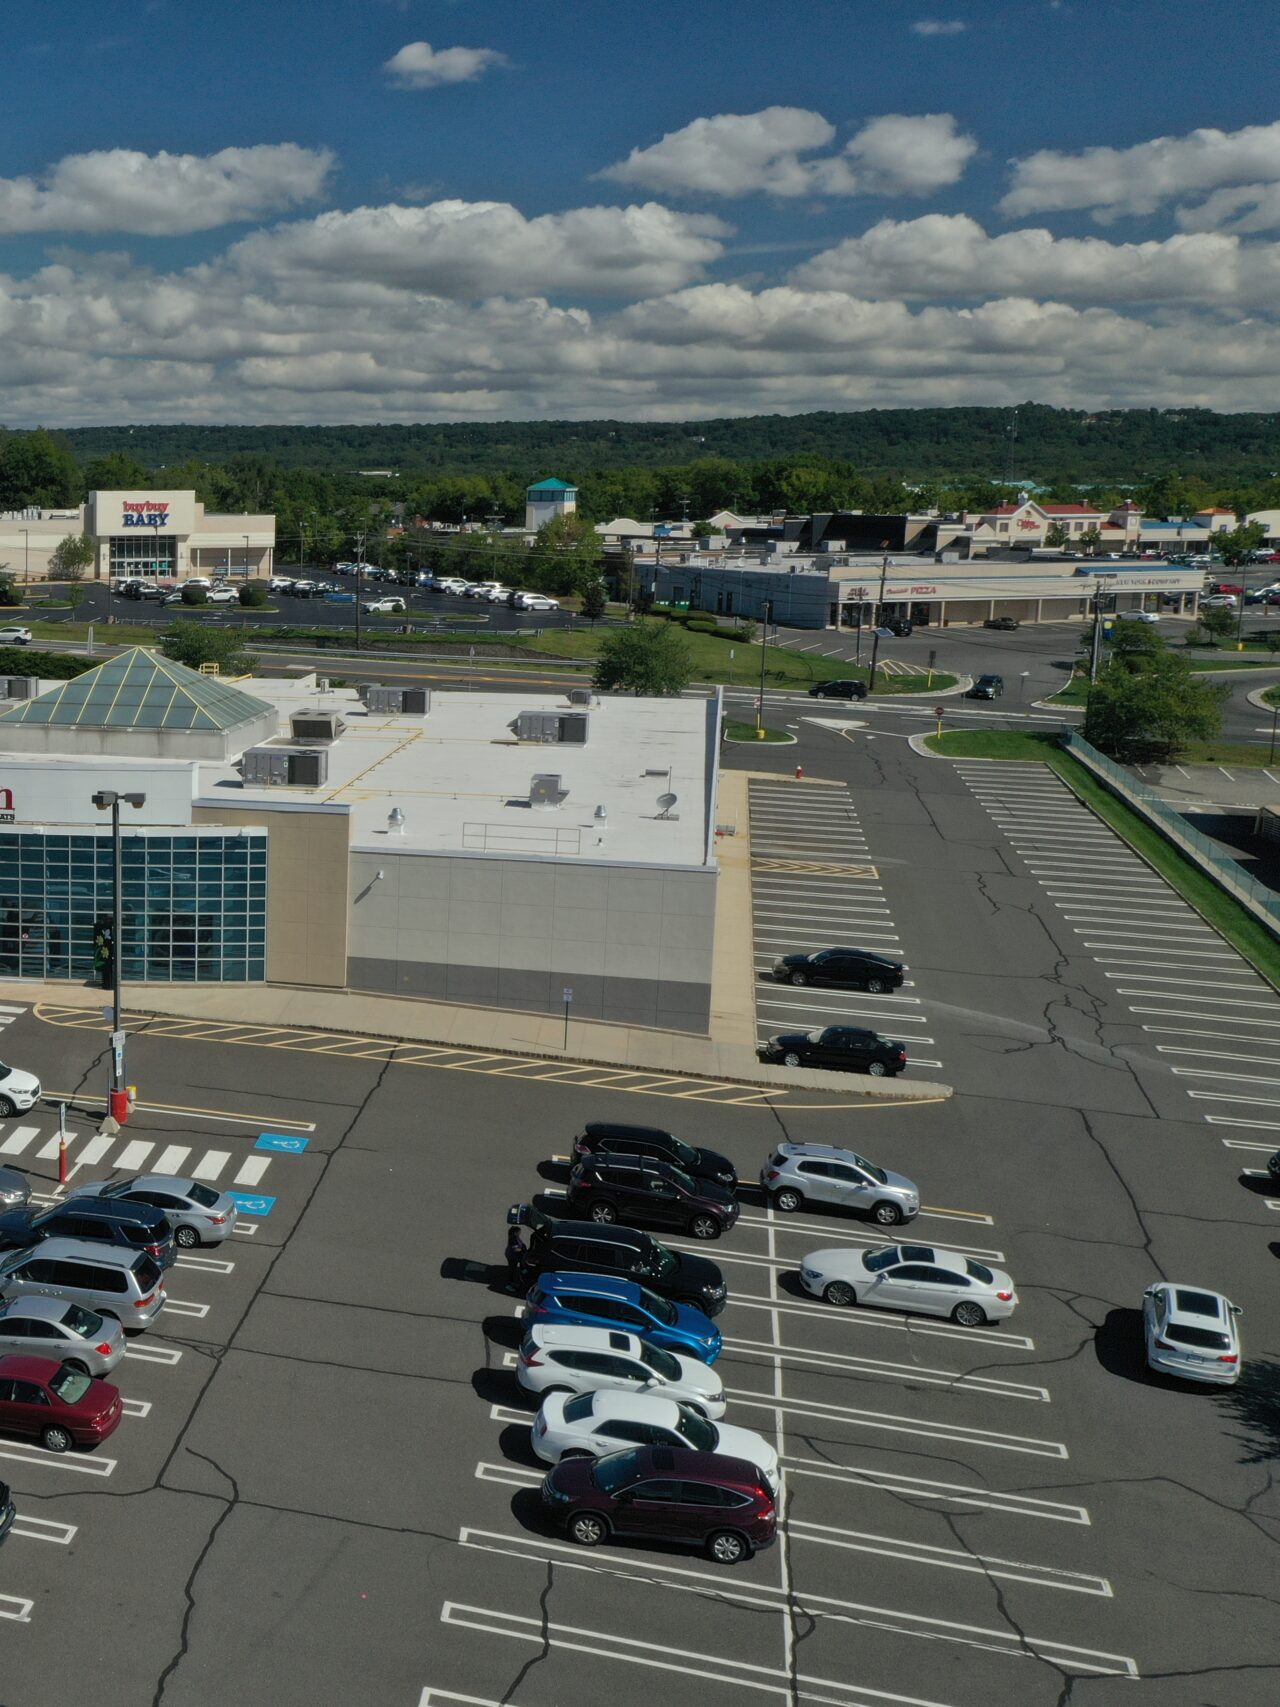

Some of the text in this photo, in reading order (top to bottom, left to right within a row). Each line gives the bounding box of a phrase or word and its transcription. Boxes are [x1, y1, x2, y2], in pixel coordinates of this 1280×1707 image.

[122, 500, 169, 514] buybuy
[122, 513, 170, 527] BABY
[910, 586, 936, 595] PIZZA
